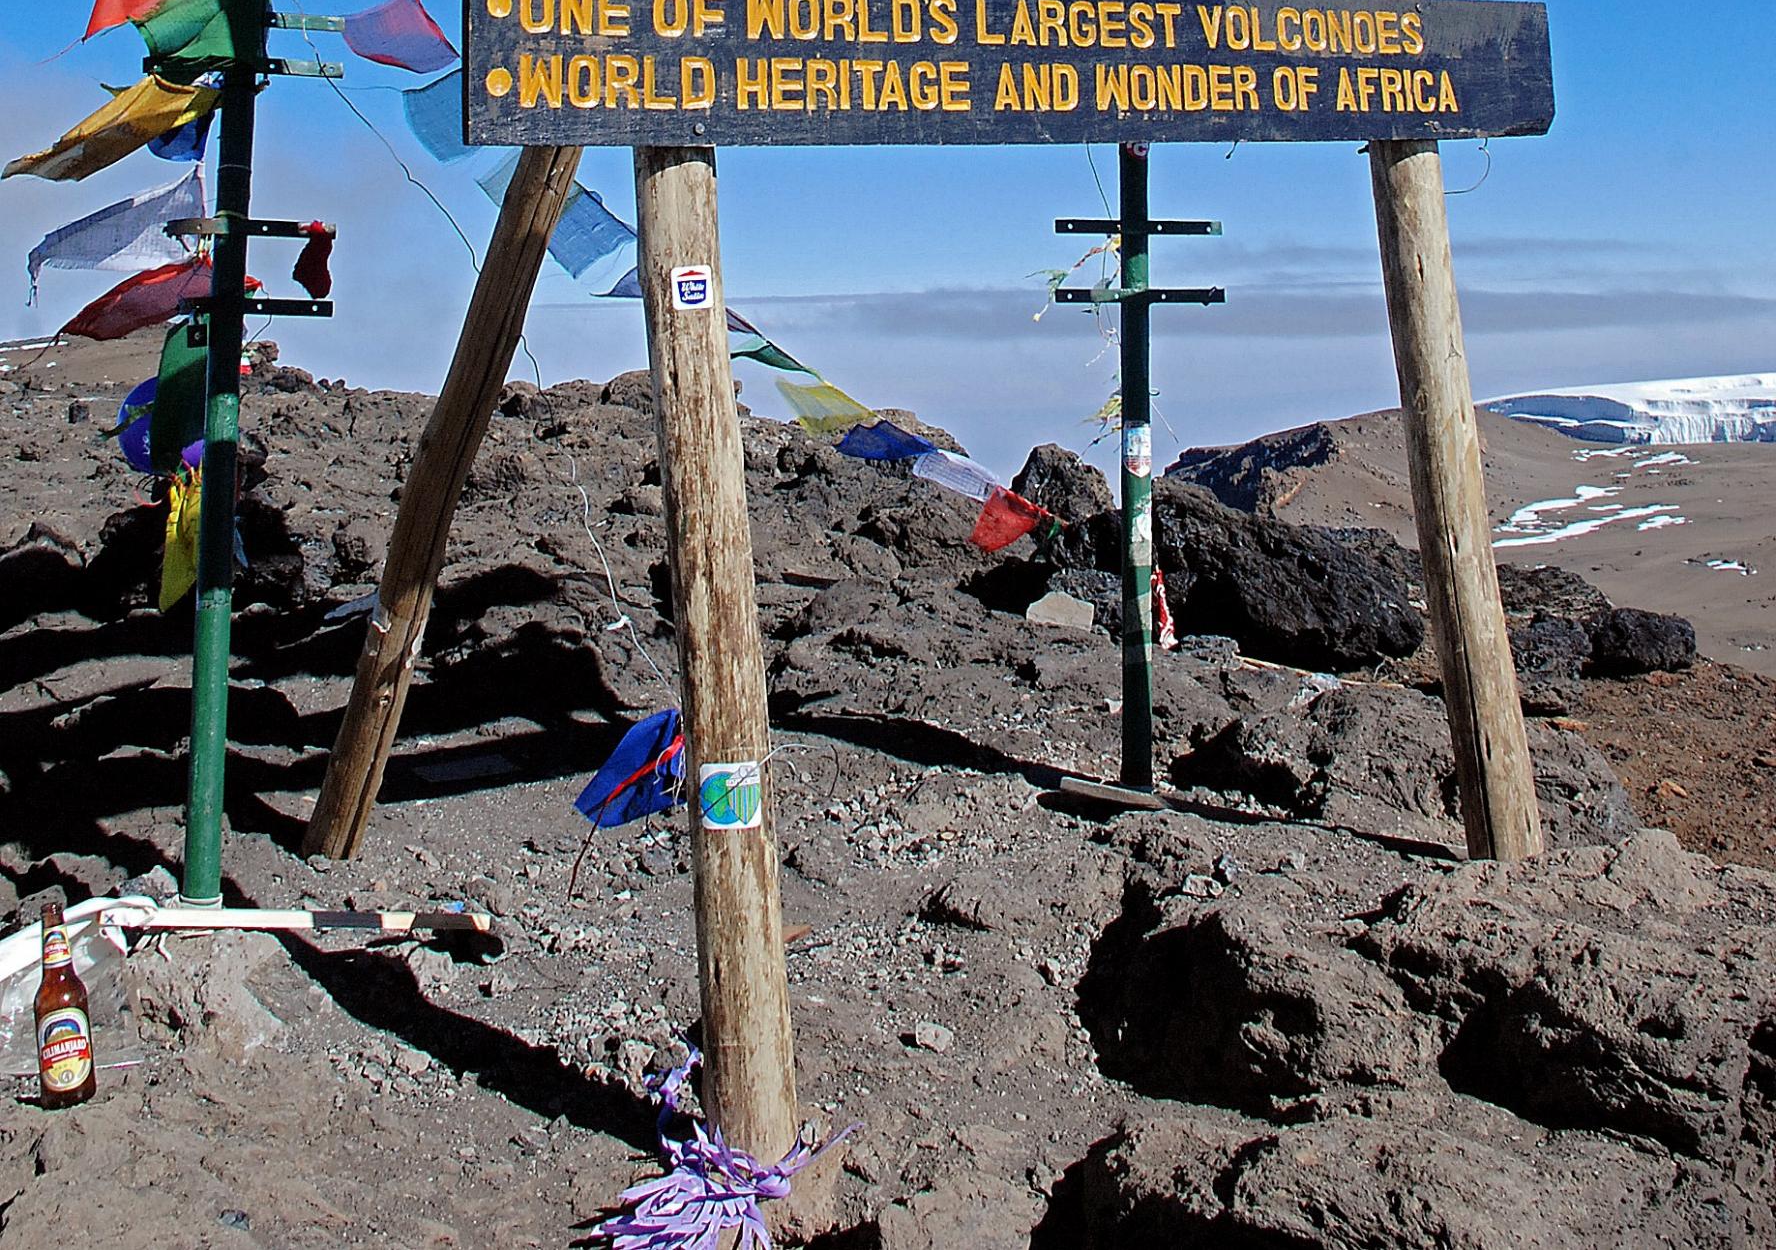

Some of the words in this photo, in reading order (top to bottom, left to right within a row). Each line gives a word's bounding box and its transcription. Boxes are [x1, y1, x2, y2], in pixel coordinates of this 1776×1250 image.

[1195, 4, 1425, 55] VOLCONOES
[519, 53, 716, 111] WORLD
[737, 56, 972, 112] HERITAGE
[994, 61, 1079, 113] AND
[1096, 63, 1260, 112] WONDER
[1273, 65, 1319, 111] OF
[1336, 66, 1459, 113] AFRICA
